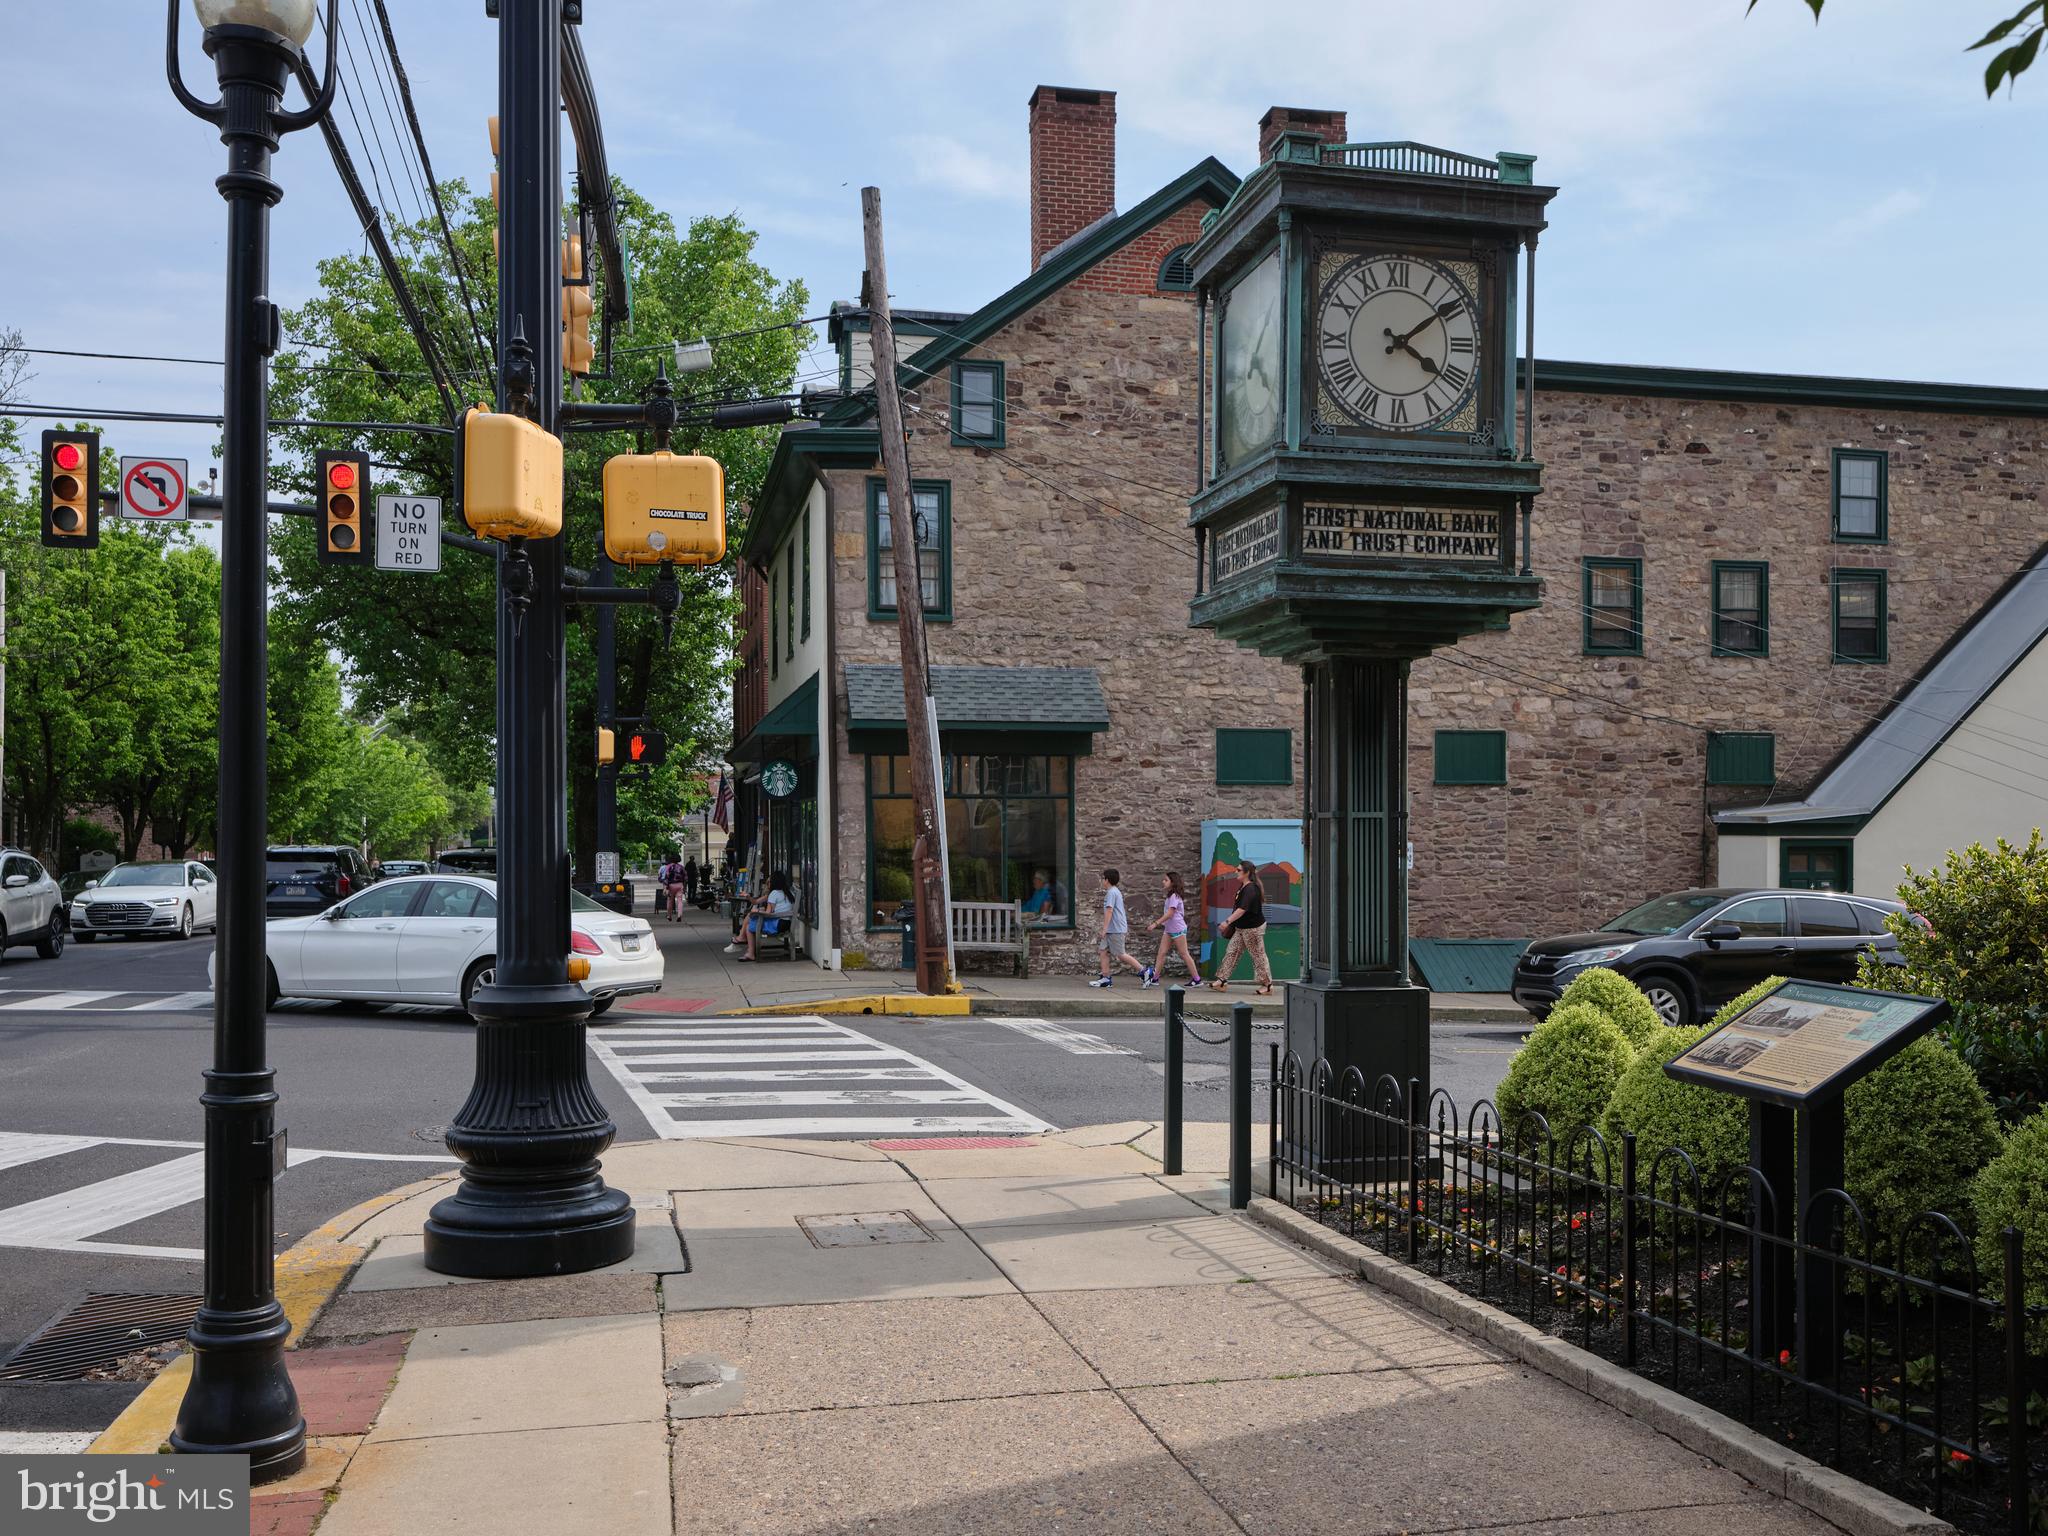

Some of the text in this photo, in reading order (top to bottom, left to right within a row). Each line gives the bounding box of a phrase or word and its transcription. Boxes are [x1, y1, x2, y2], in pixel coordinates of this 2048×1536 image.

[394, 502, 426, 519] NO
[651, 509, 706, 519] CHOCOLATE TRUCK
[1306, 507, 1498, 533] FIRST NATIONAL BANK
[390, 521, 427, 535] TURN
[398, 537, 419, 549] ON
[1306, 530, 1498, 555] AND TRUST COMPANY
[395, 552, 423, 564] RED
